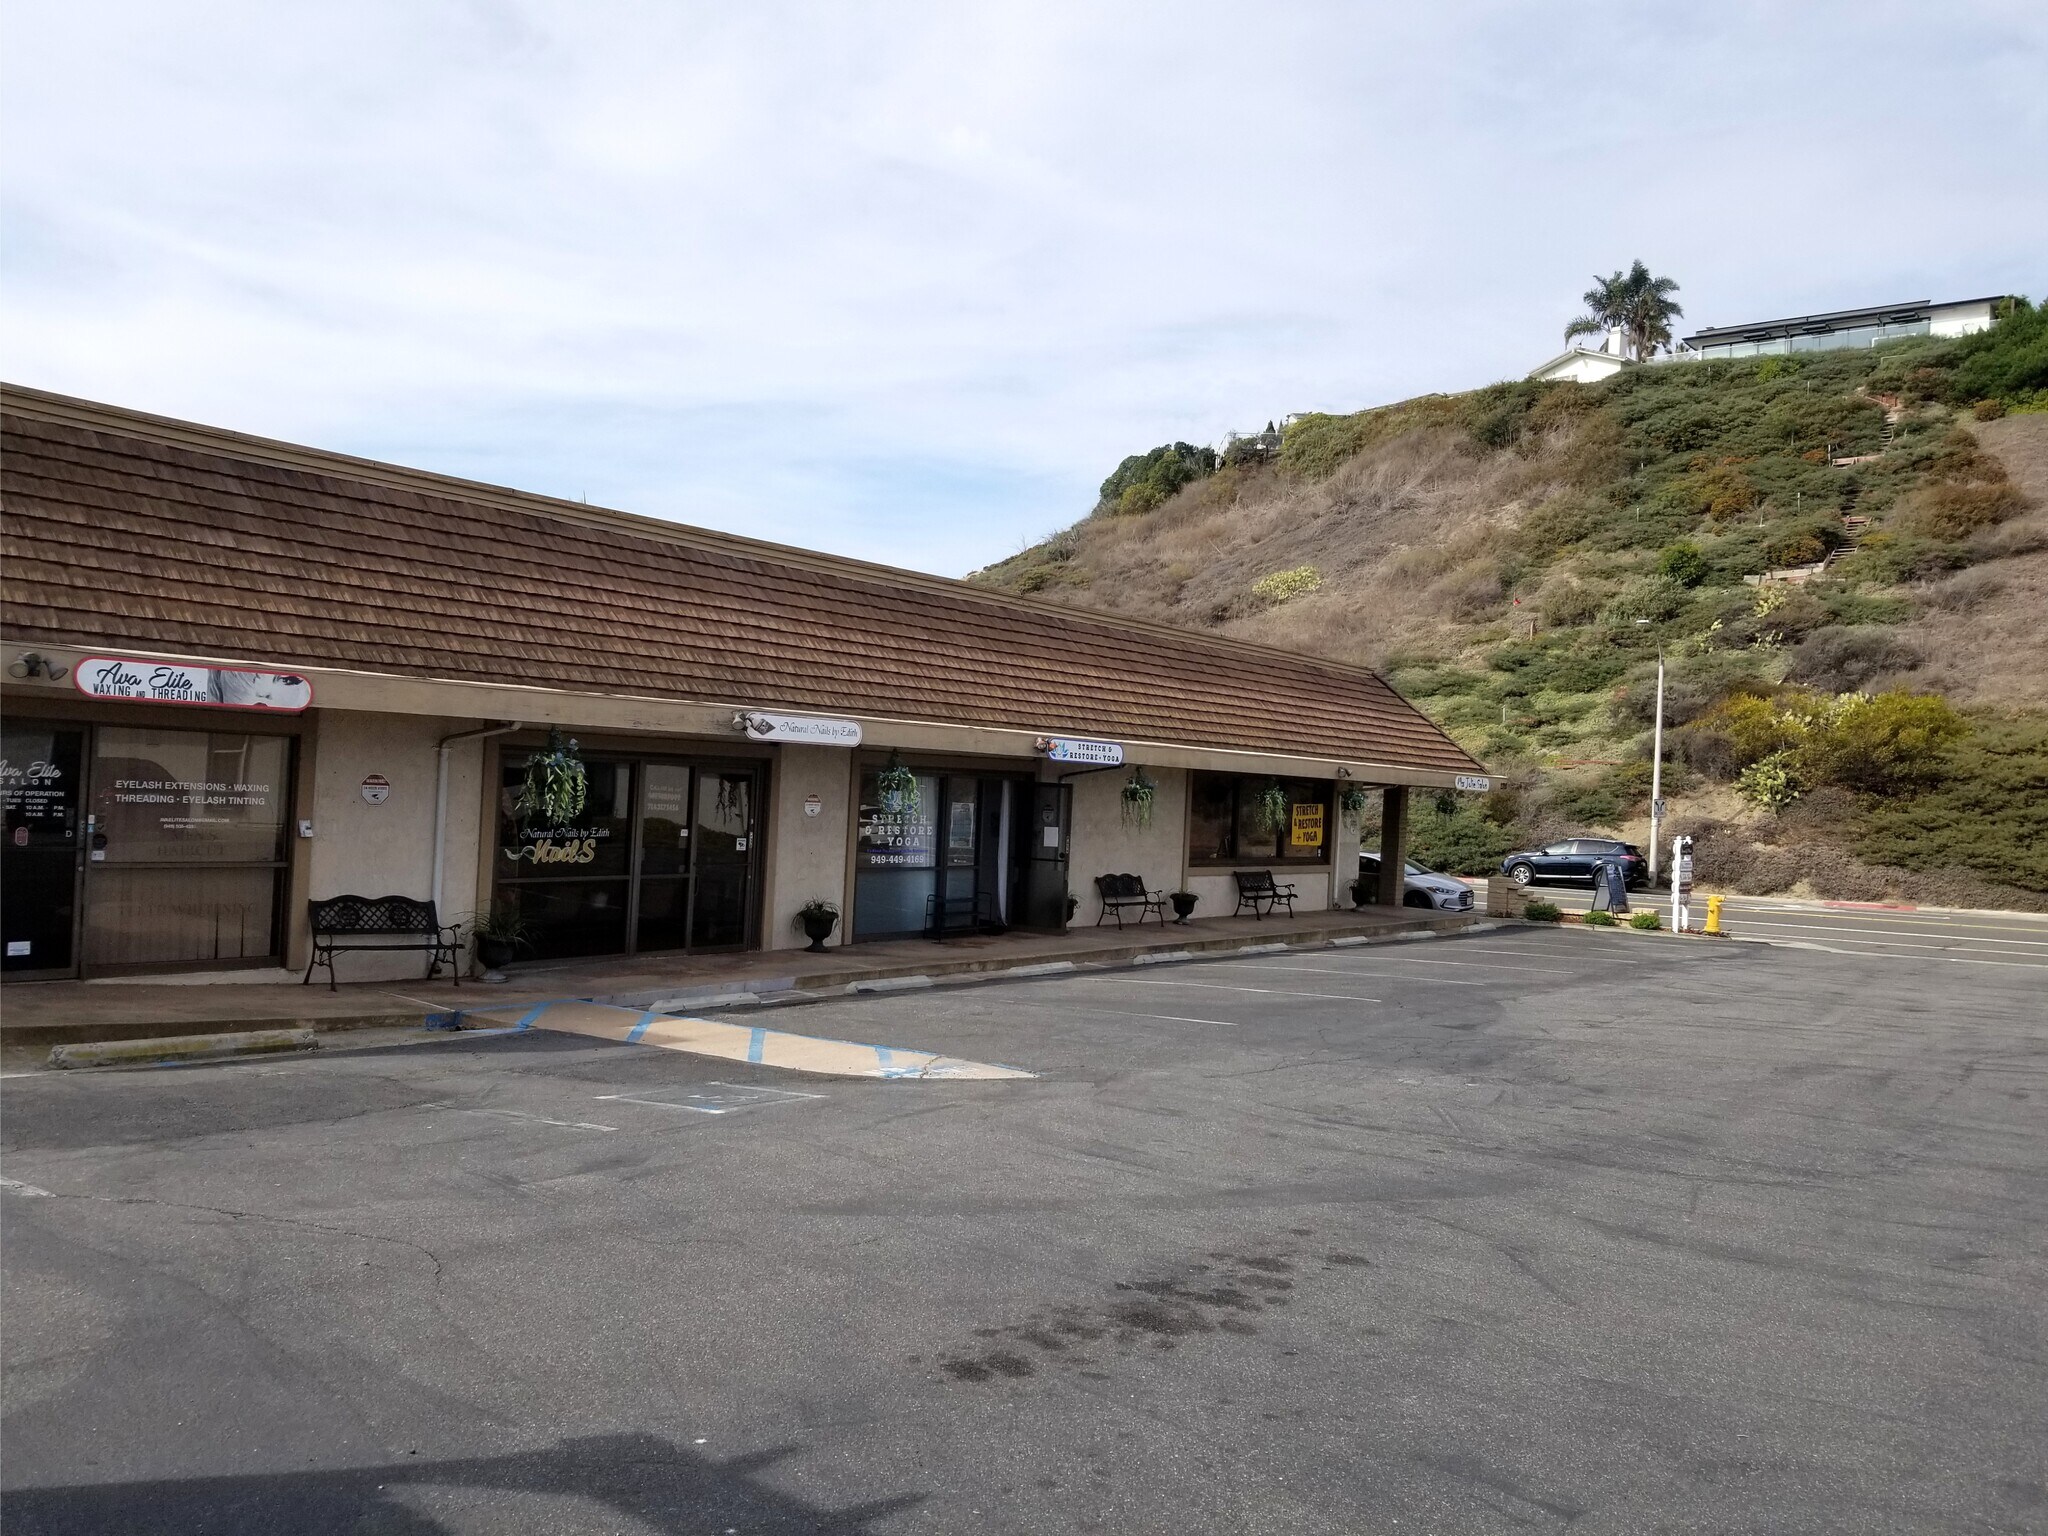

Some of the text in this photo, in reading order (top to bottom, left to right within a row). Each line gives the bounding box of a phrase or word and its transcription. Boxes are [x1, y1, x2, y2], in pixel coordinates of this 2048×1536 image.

[97, 662, 193, 689] Ava Elite
[93, 683, 207, 703] WAXING AND THREADING
[779, 721, 858, 739] Natural Nails by Edith
[1077, 743, 1107, 753] STRETCH
[1069, 751, 1098, 761] RESTORE
[27, 761, 62, 778] Elite
[115, 780, 270, 793] EYELASH EXTENSIONS WAXING
[115, 793, 265, 806] THREADING EYELASH TINTING
[1295, 805, 1319, 816] STRETCH
[878, 825, 933, 835] RESTORE
[1298, 818, 1322, 830] RESTORE
[520, 826, 610, 840] Natural Nails by Edith
[1302, 831, 1318, 843] YOGA
[887, 837, 920, 847] YOGA
[870, 855, 925, 864] 949-449-4169
